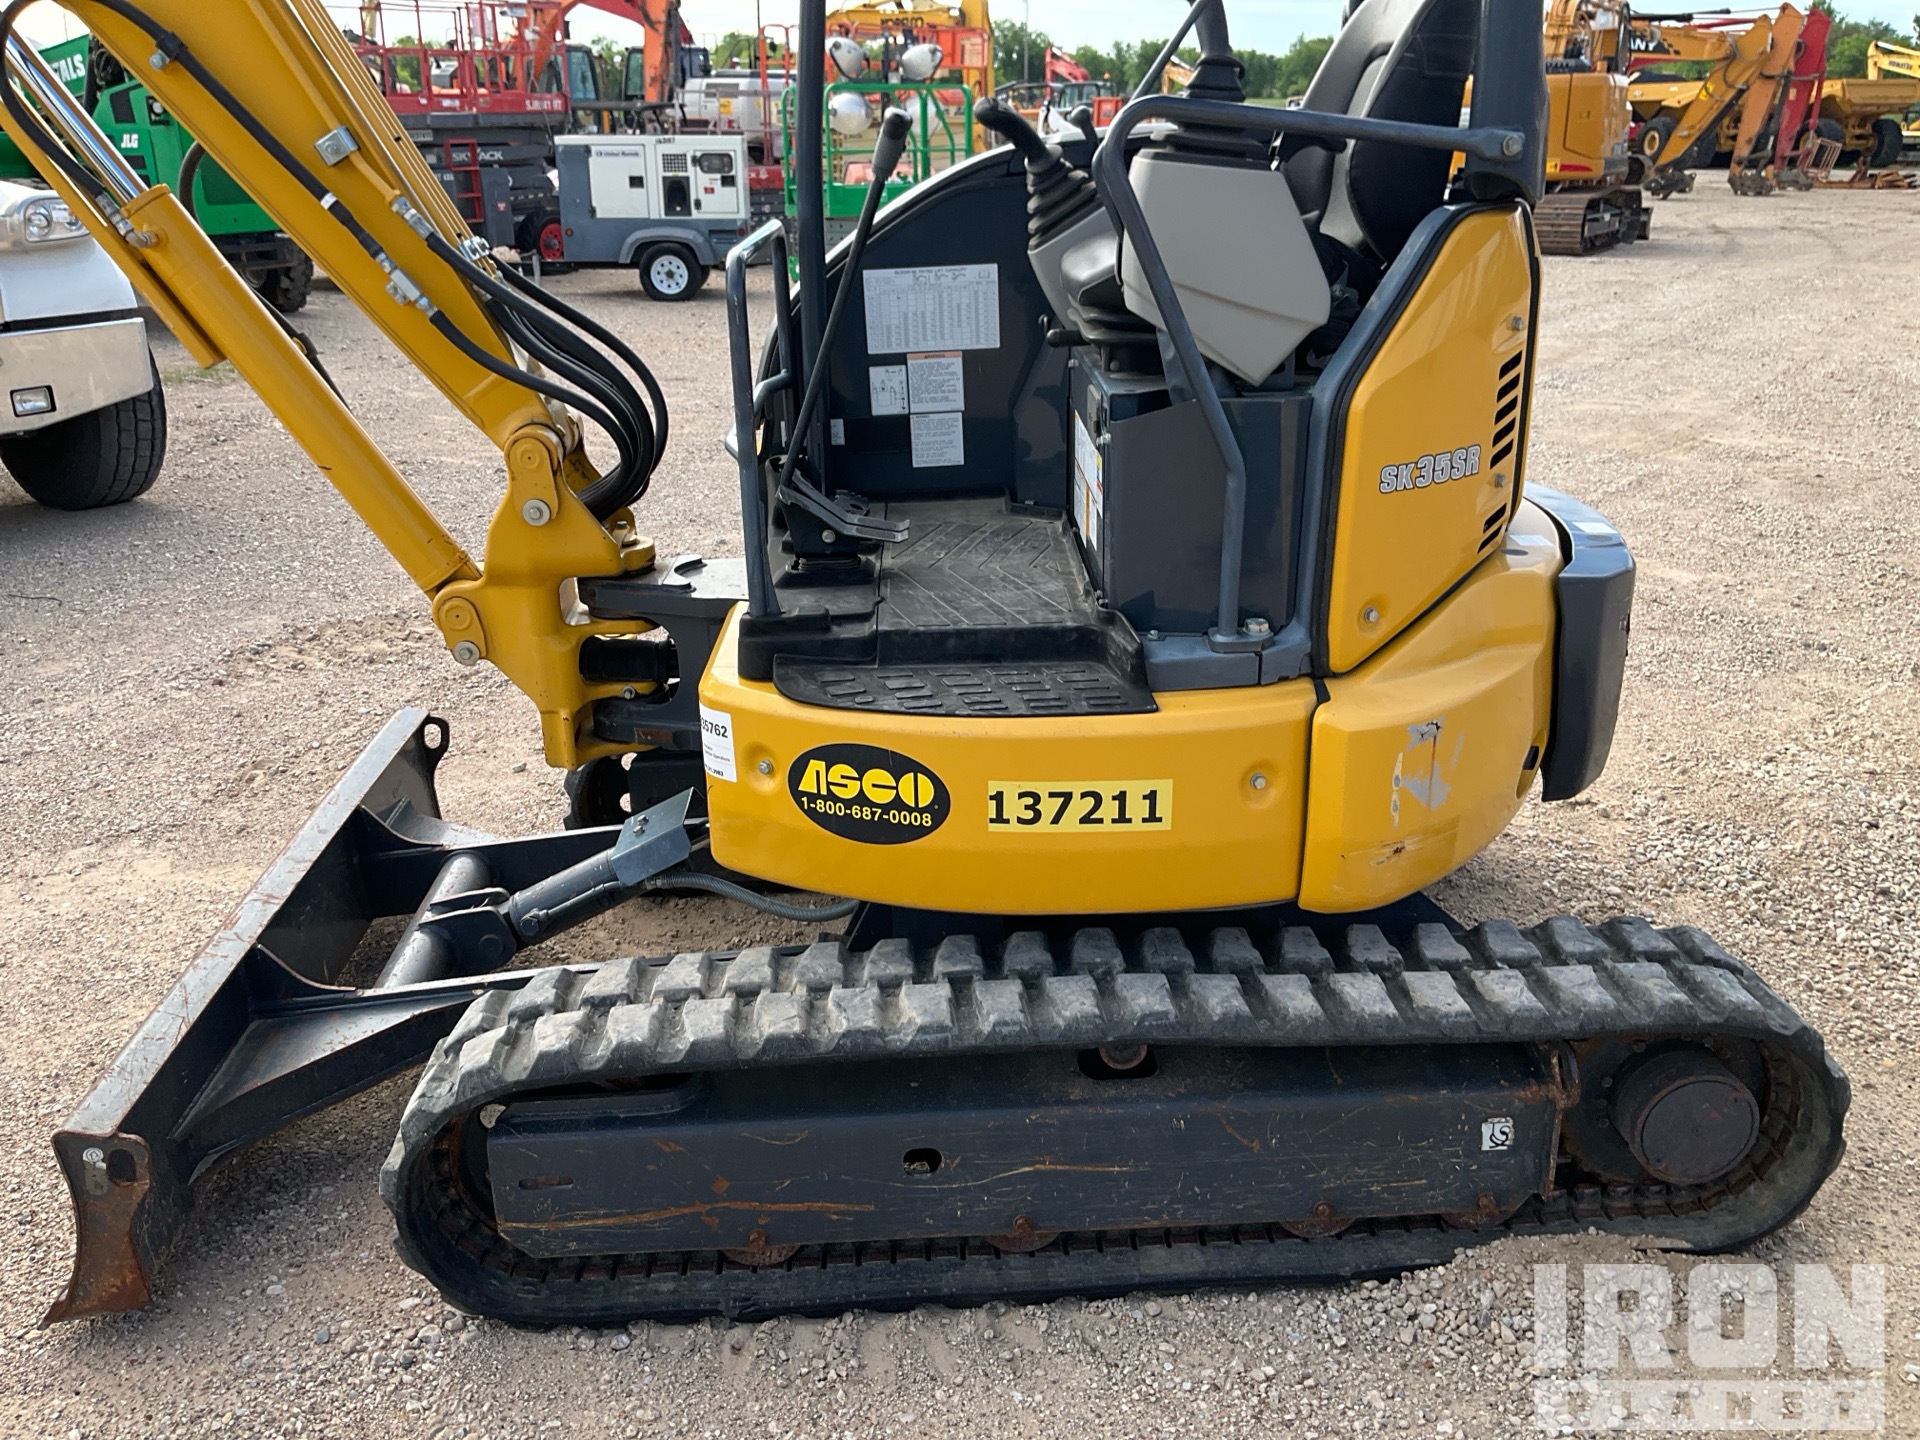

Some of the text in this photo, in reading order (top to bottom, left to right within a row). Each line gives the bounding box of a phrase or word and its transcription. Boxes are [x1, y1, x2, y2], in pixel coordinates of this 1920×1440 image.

[121, 133, 139, 149] JLG
[452, 149, 504, 161] SKACK
[1379, 444, 1481, 493] SK35SR
[798, 759, 934, 808] ASCO
[801, 796, 932, 827] 1-800-687-0008
[988, 790, 1163, 825] 137211
